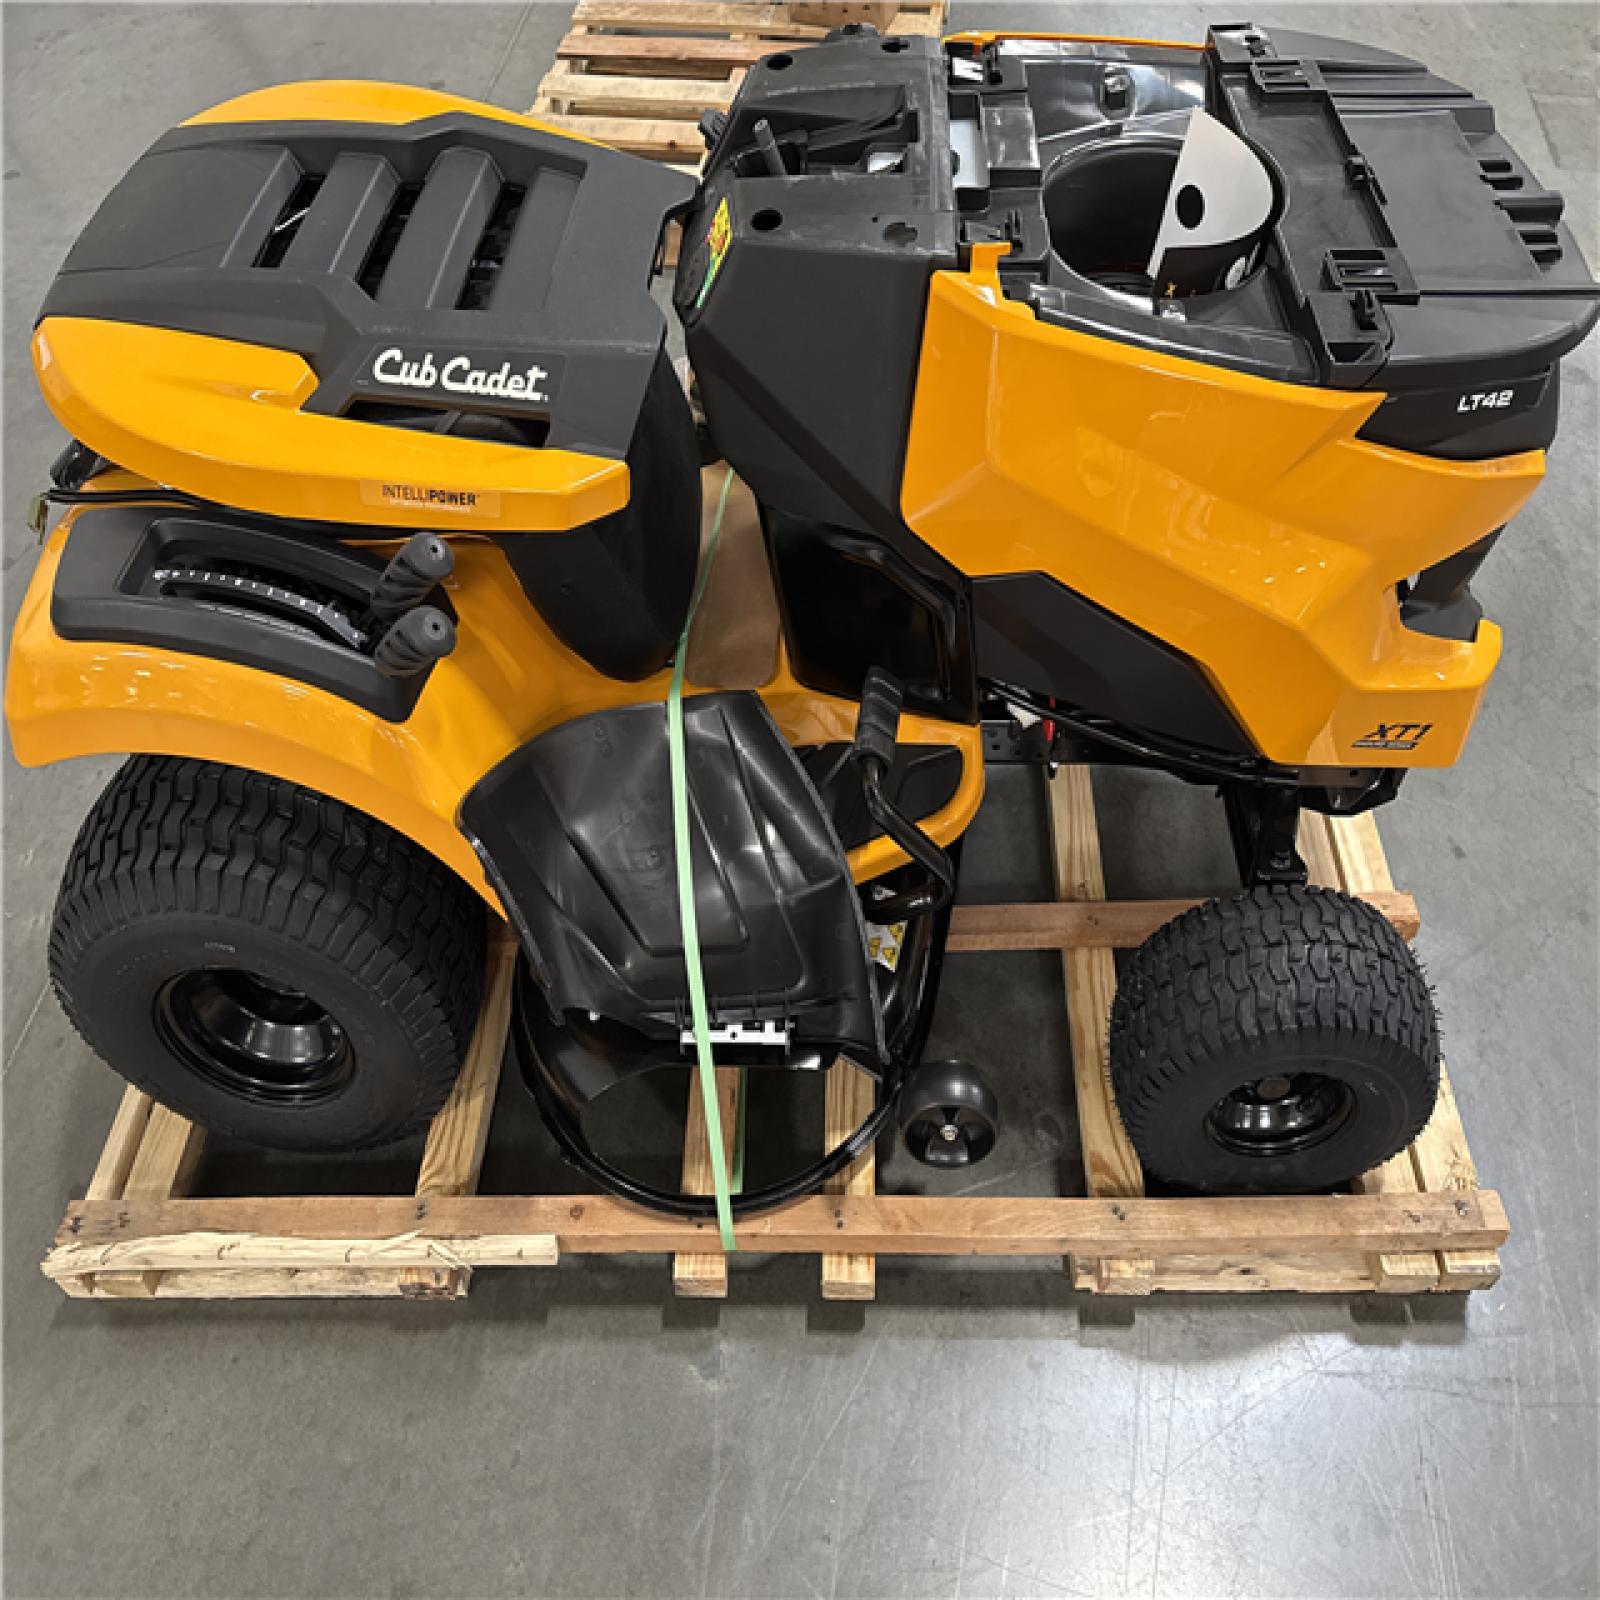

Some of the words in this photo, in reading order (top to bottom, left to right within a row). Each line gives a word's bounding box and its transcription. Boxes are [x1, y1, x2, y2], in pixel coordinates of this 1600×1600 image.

[373, 348, 437, 388] Cub
[441, 355, 548, 401] Cadet
[1457, 388, 1514, 412] LT42
[381, 484, 476, 506] INTELLIPOWER
